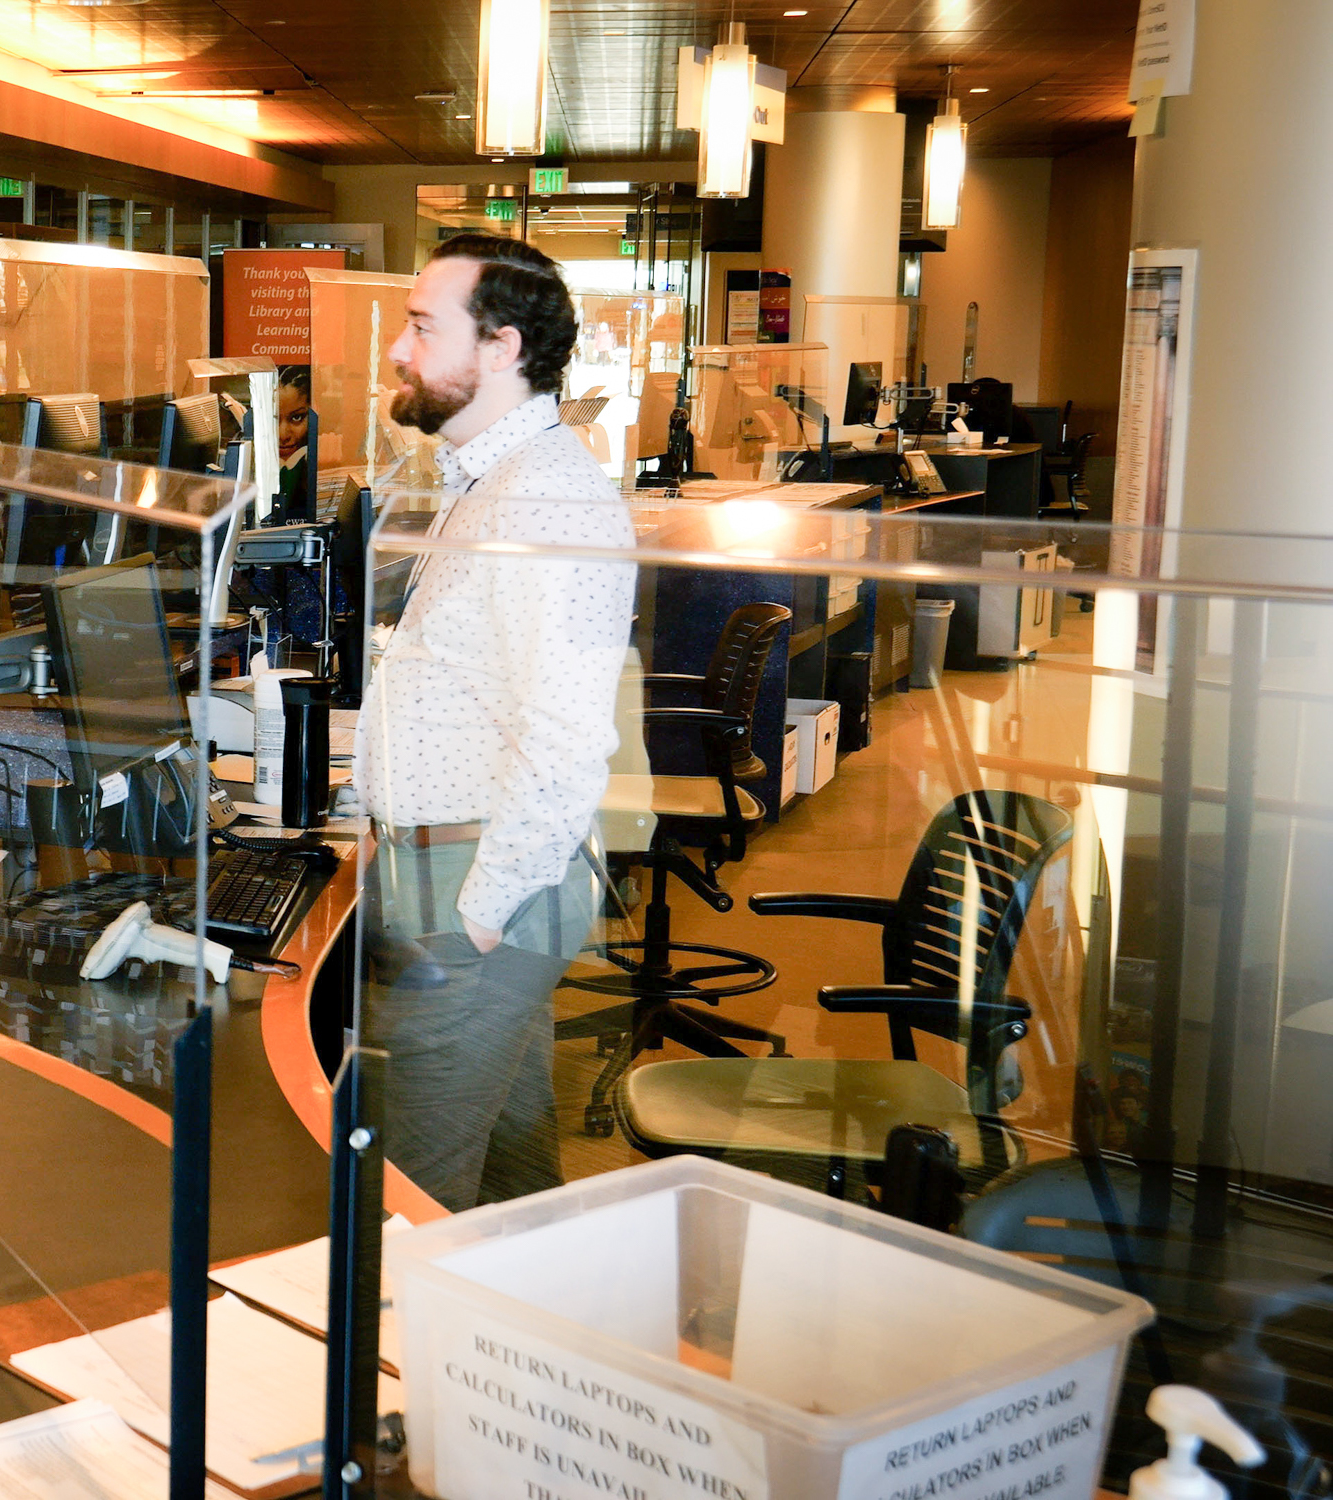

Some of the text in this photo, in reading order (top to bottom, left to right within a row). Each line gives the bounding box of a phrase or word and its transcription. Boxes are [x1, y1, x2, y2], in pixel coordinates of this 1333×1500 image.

[535, 170, 563, 192] EXIT
[243, 266, 305, 283] Thank you
[251, 286, 296, 301] visiting
[249, 305, 293, 320] Library
[256, 324, 310, 339] Learning
[251, 342, 311, 355] Commons
[473, 1333, 712, 1446] RETURN LAPTOPS AND
[445, 1361, 749, 1500] CALCULATORS IN BOX WHEN
[884, 1379, 1078, 1472] RETURN LAPTOPS AND
[468, 1413, 528, 1455] STAFF
[533, 1442, 552, 1466] IS
[985, 1448, 1003, 1471] IN
[1007, 1432, 1043, 1464] BOX
[1046, 1411, 1092, 1447] WHEN
